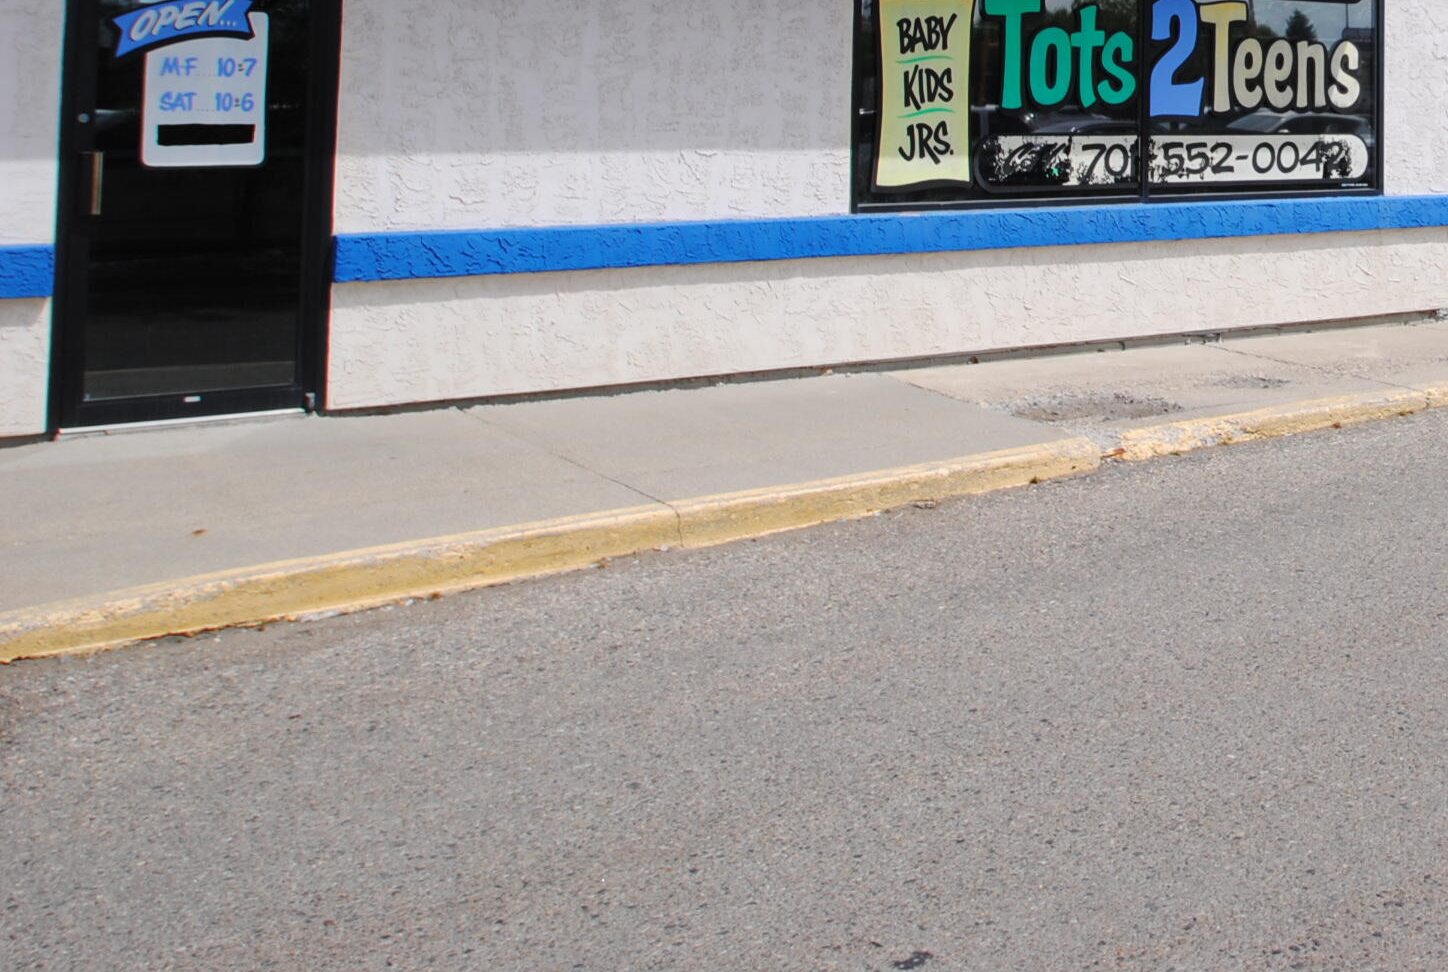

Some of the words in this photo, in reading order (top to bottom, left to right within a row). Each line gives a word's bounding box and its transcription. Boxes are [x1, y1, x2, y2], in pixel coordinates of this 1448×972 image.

[897, 12, 959, 55] BABY
[1199, 0, 1361, 113] Teens
[159, 91, 198, 112] SAT
[902, 63, 954, 111] KIDS
